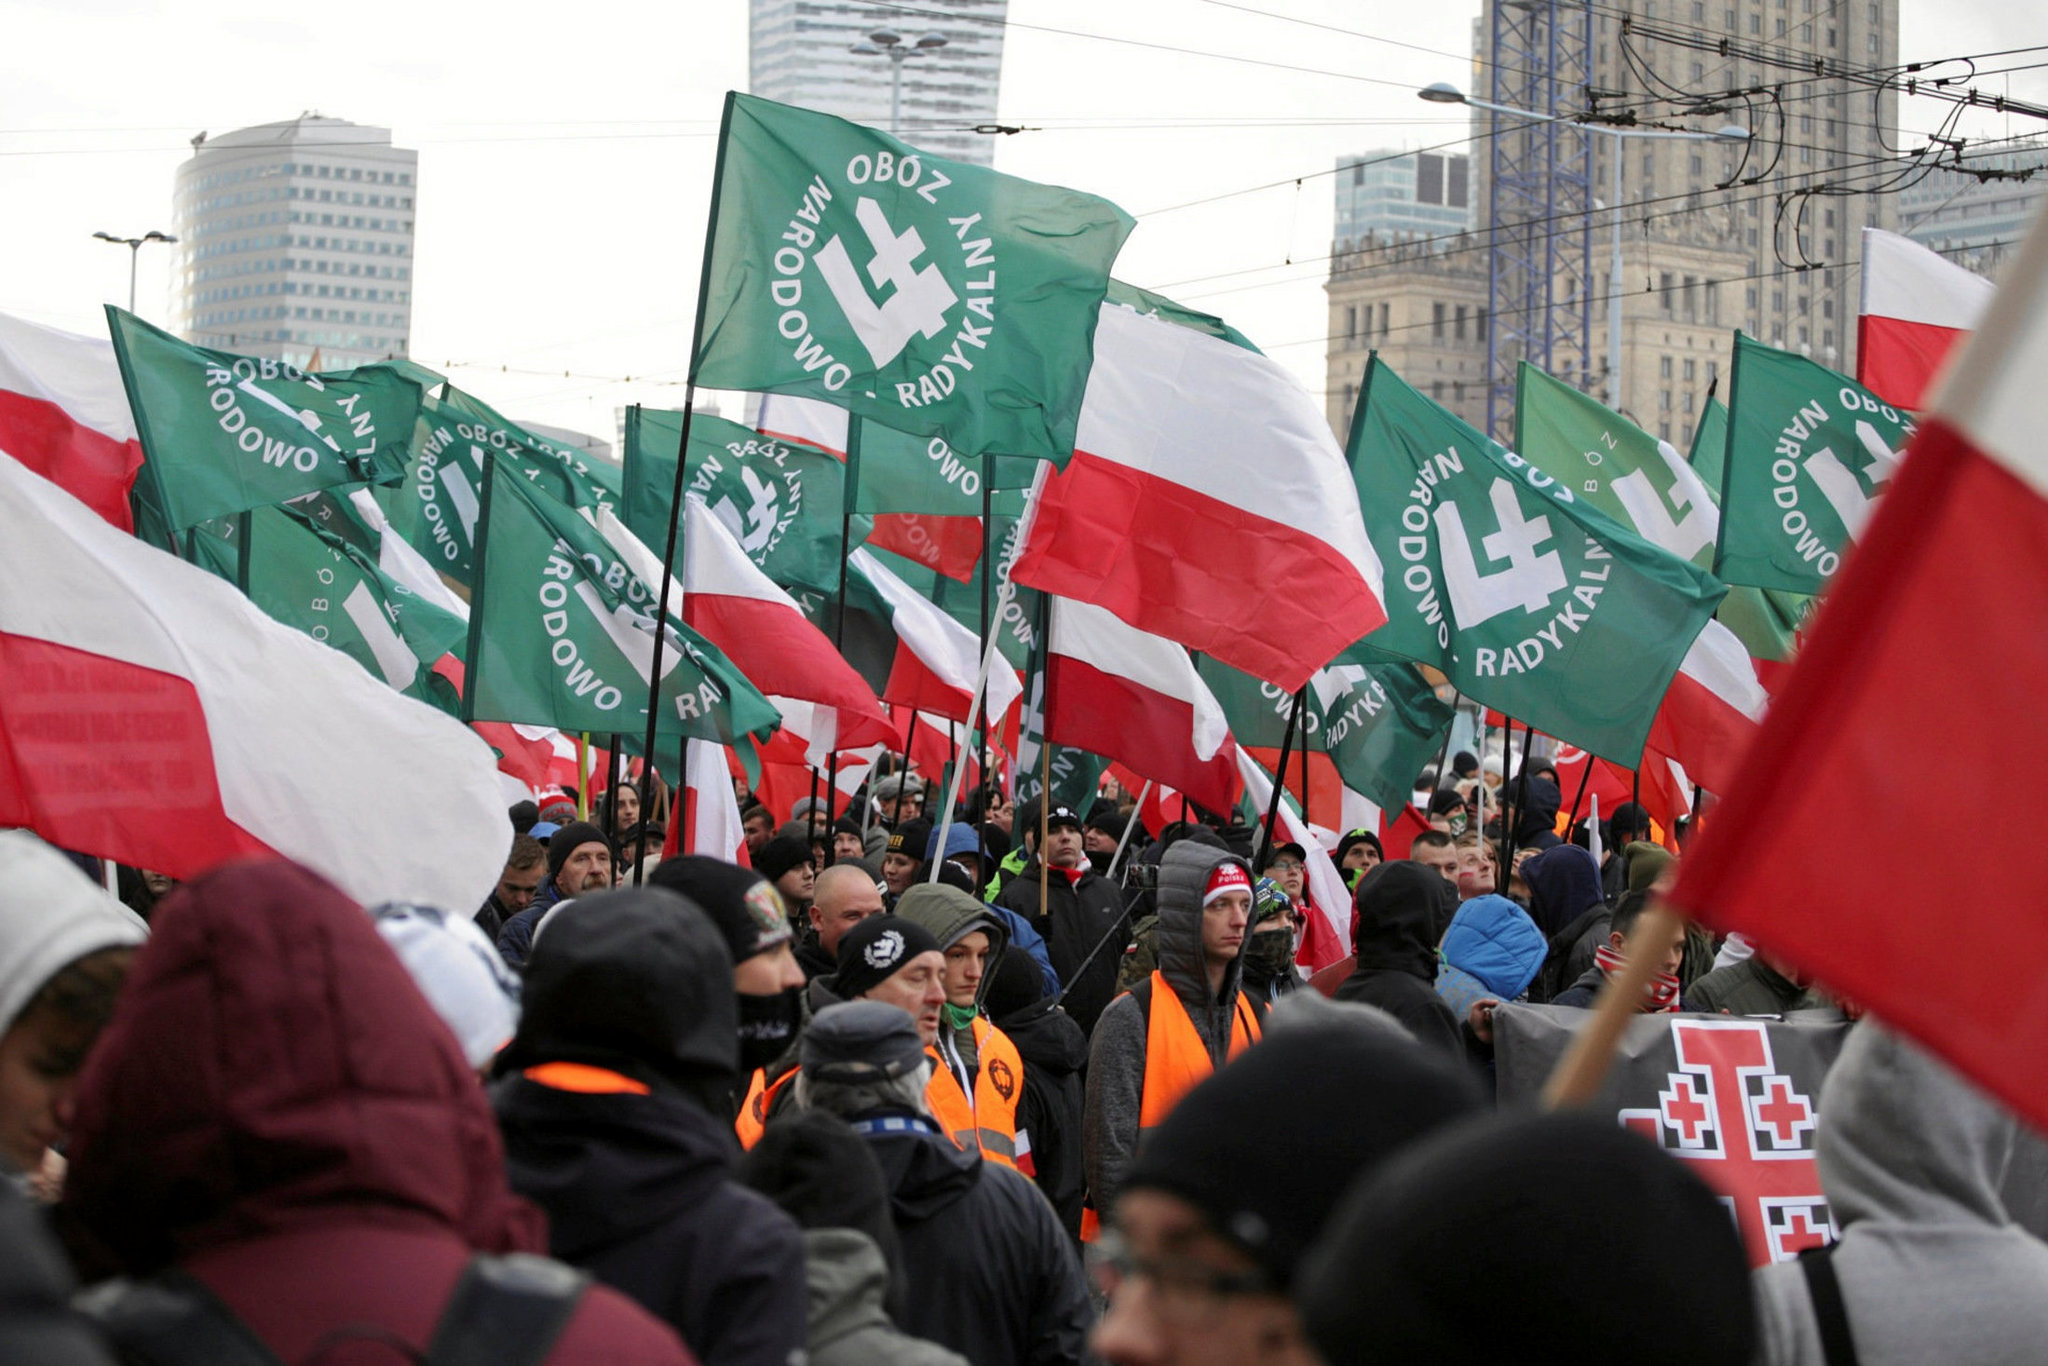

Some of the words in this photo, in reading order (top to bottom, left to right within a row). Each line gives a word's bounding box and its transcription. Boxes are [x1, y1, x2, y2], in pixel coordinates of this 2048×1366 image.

[846, 151, 952, 205] OBÓZ
[771, 174, 852, 391] NARODOWO
[895, 212, 996, 409] RADYKALNY
[206, 364, 319, 472] RODOWO
[456, 423, 524, 460] OBÓZ
[1584, 431, 1618, 493] BÓZ
[417, 426, 459, 561] NARODOWO
[755, 469, 803, 566] YKALNY
[1399, 446, 1464, 649] NARODOWO
[1772, 399, 1840, 577] NARODOWO
[539, 543, 622, 711] RODOWO
[1475, 535, 1613, 677] RADYKALN
